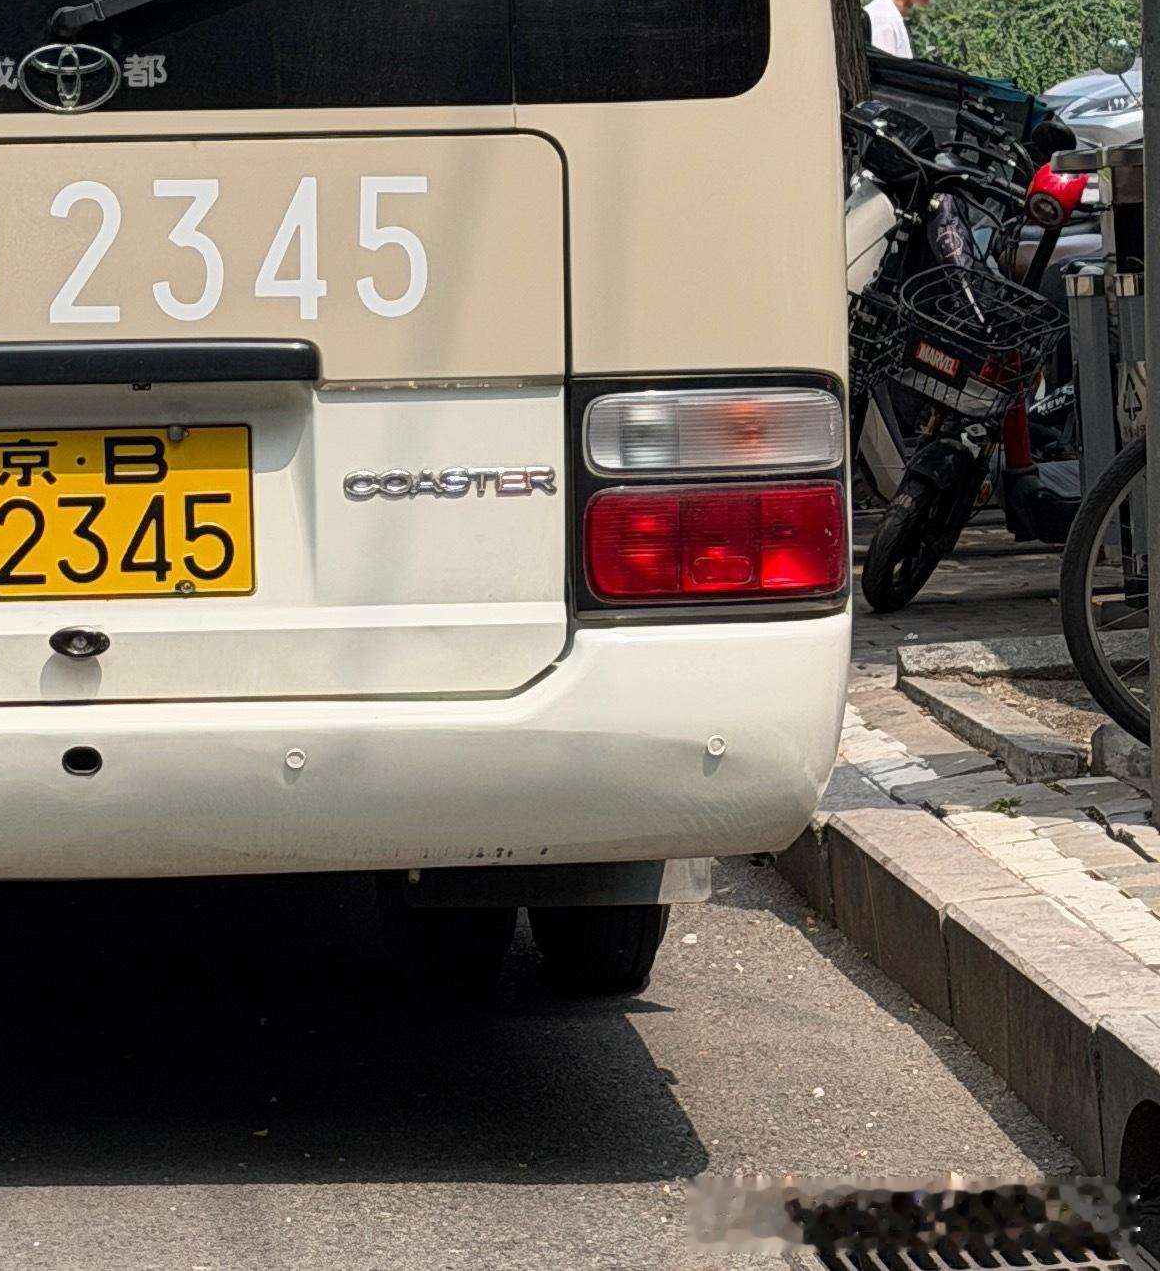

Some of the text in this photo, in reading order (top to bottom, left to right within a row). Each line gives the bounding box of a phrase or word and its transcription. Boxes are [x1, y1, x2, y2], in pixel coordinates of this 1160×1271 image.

[915, 341, 960, 378] MARVEL
[1037, 395, 1066, 414] NEW
[343, 466, 558, 500] COASTER
